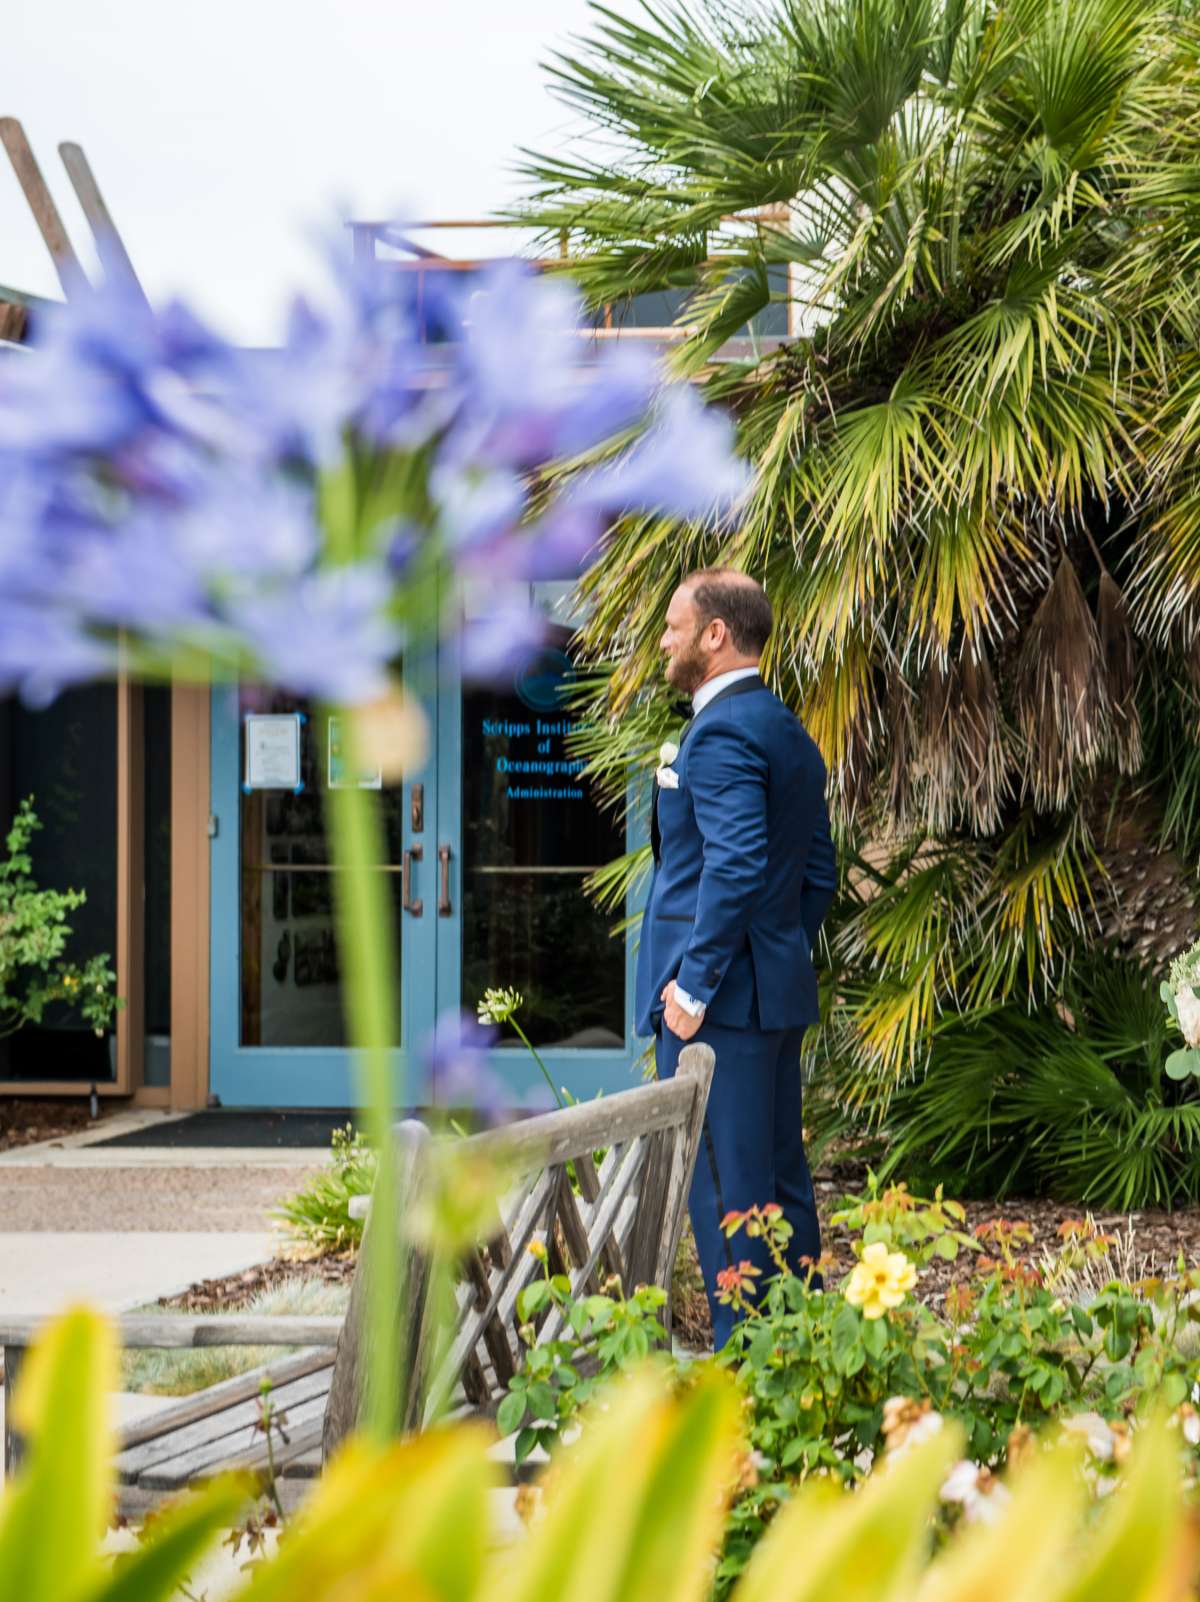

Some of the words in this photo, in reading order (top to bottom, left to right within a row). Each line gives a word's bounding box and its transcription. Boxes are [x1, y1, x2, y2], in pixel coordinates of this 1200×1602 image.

[482, 719, 531, 737] Scripps
[537, 738, 551, 753] of
[496, 755, 588, 776] Oceanograph
[506, 785, 584, 799] Administration
